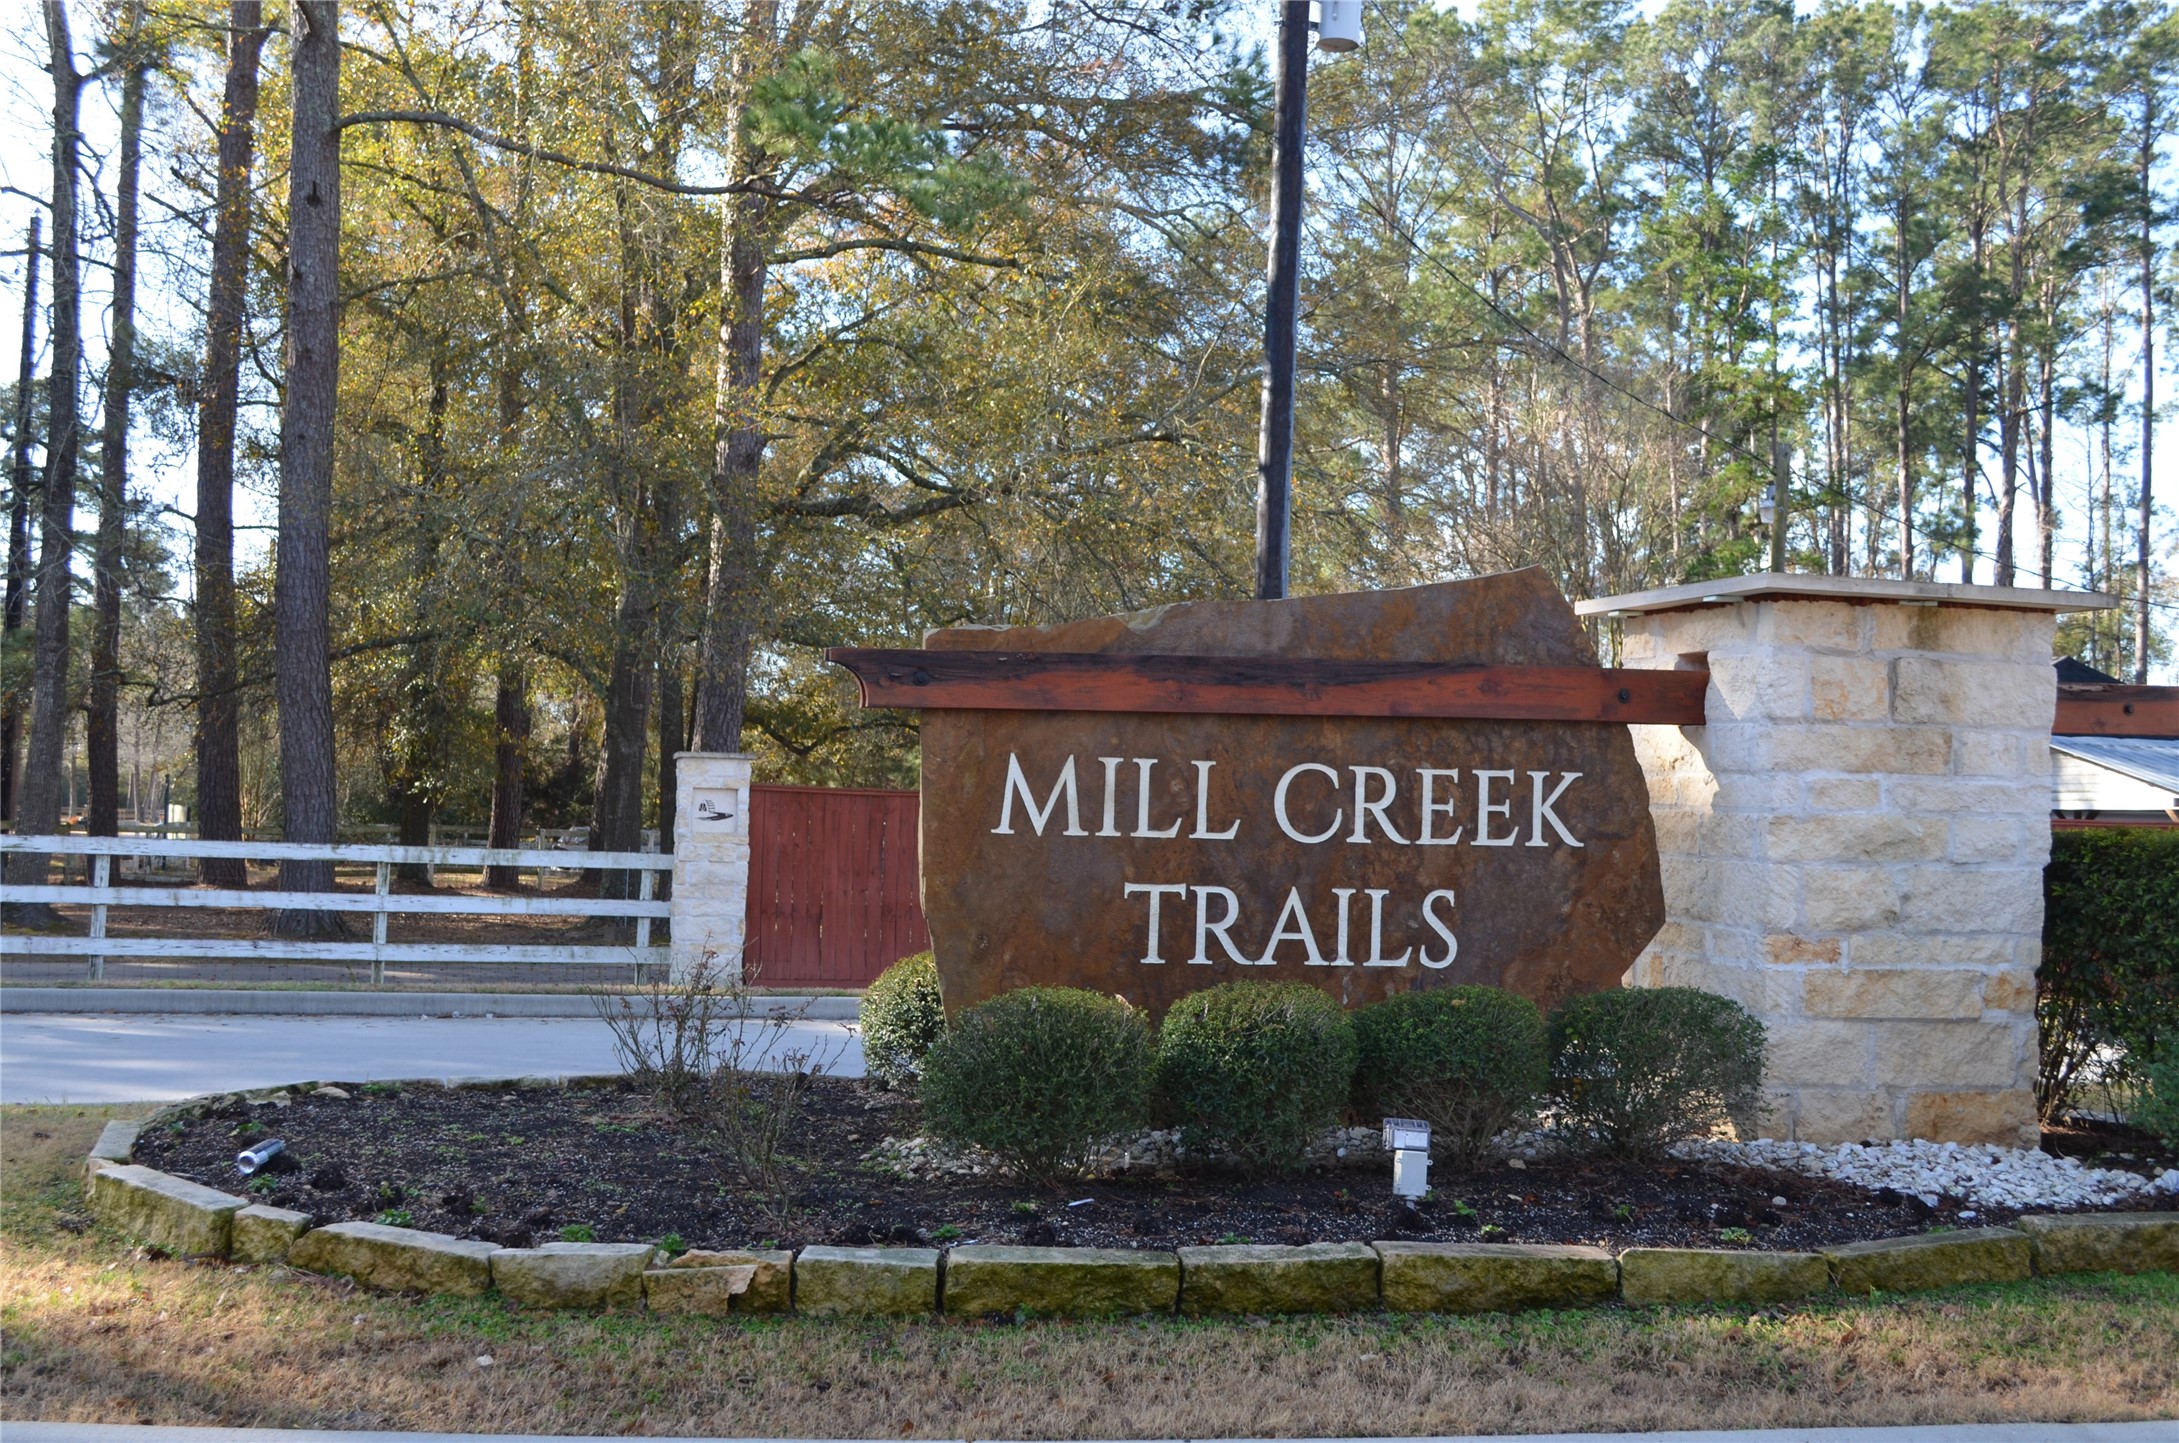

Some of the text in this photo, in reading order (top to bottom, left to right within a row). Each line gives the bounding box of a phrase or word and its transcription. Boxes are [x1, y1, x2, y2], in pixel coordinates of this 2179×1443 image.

[991, 752, 1584, 848] MILL CREEK
[1123, 882, 1457, 970] TRAILS
